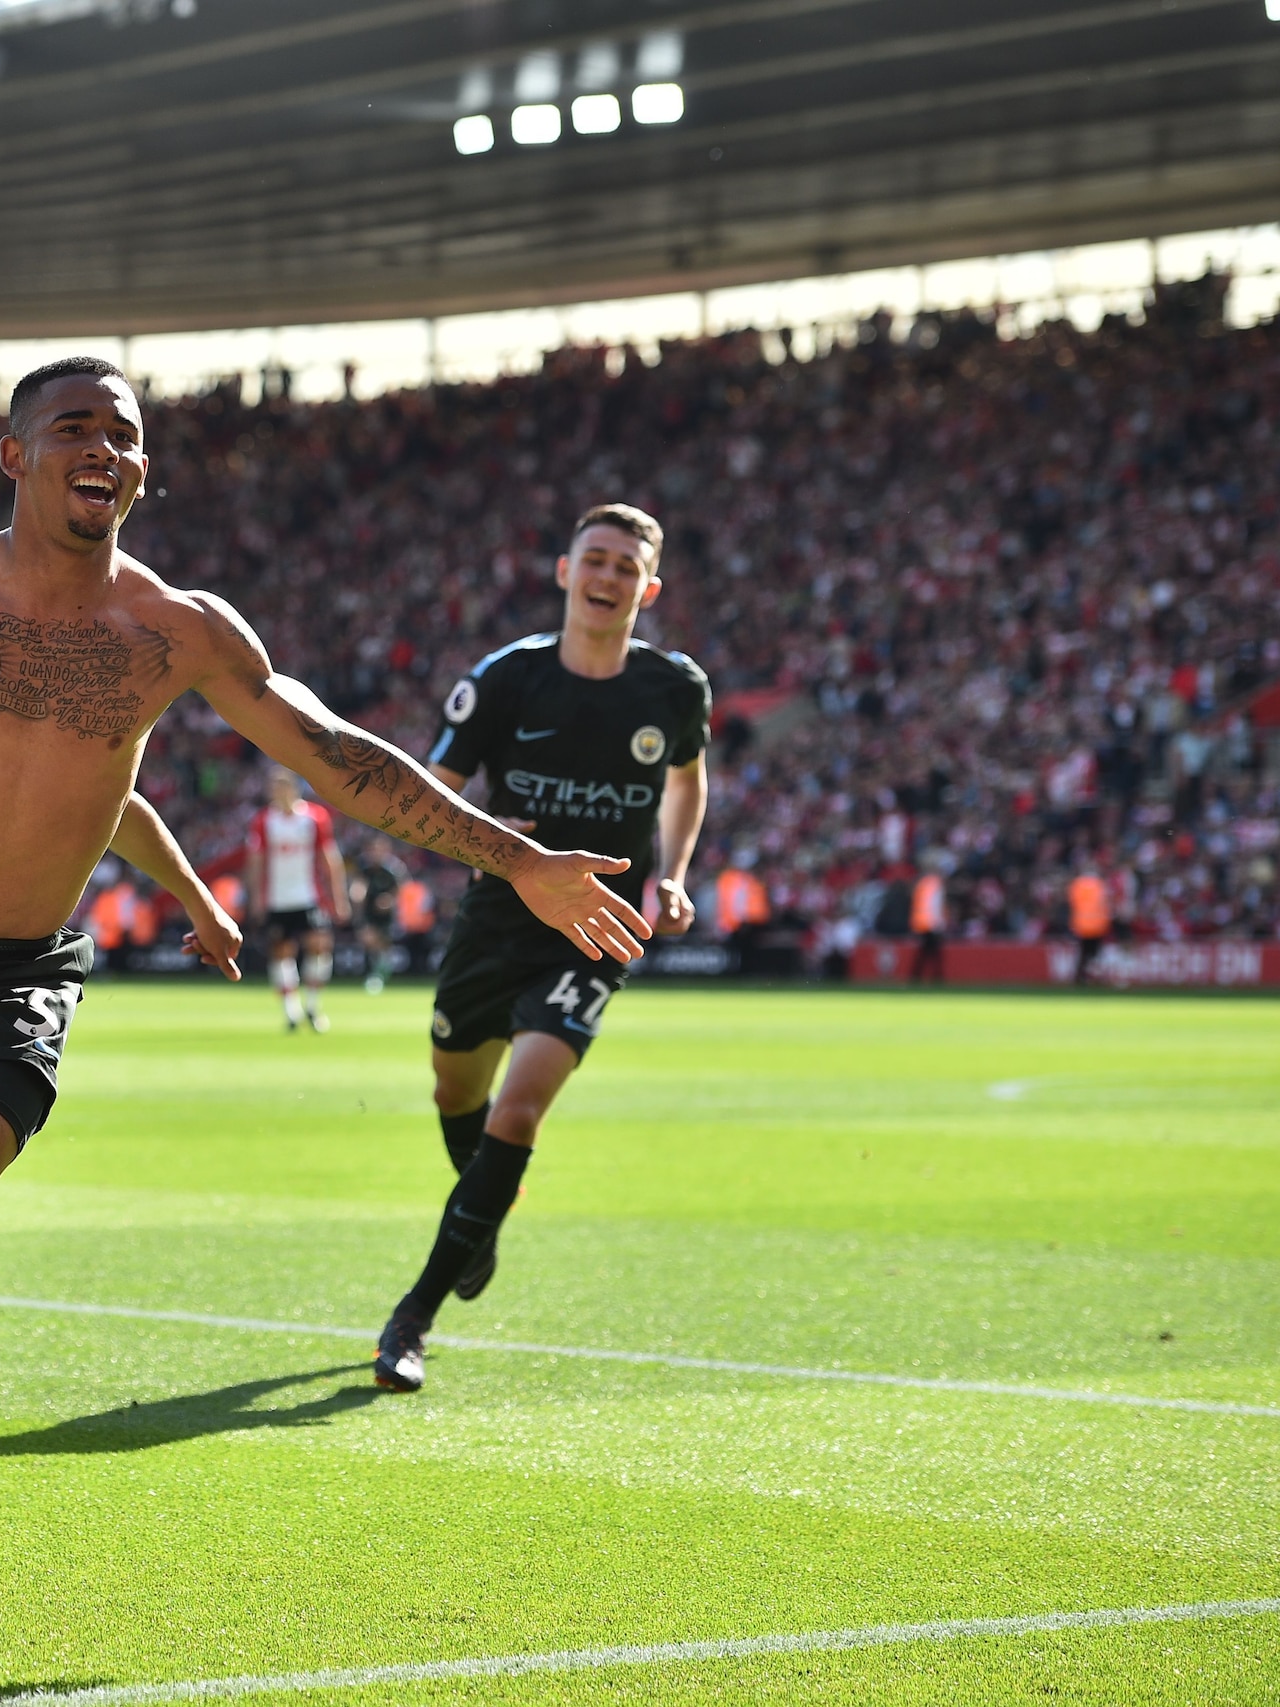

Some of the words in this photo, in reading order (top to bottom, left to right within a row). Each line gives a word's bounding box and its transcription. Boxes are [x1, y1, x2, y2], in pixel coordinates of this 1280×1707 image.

[20, 660, 70, 681] QUANDO
[75, 656, 122, 671] VIVO
[504, 769, 654, 808] ETIHAD
[524, 799, 624, 823] AIRWAYS
[545, 970, 612, 1025] 47
